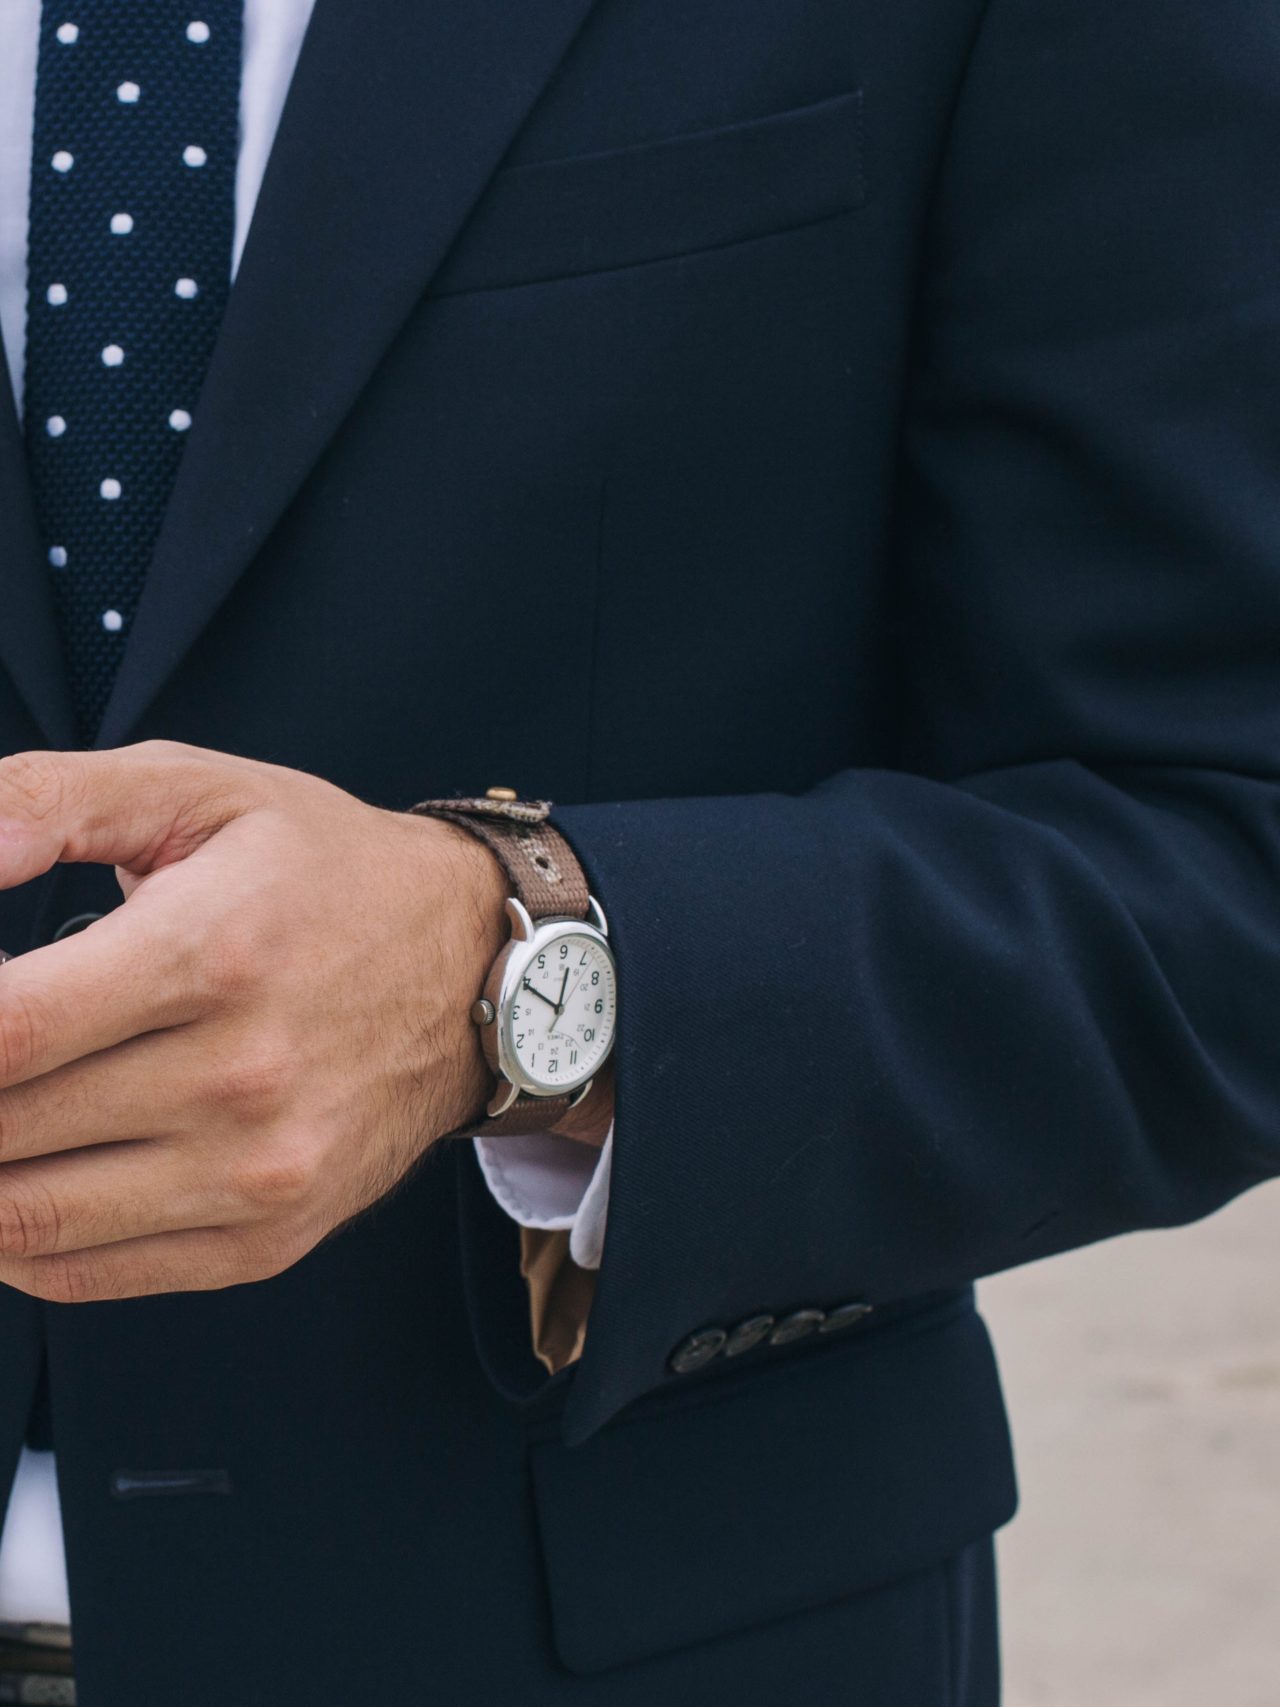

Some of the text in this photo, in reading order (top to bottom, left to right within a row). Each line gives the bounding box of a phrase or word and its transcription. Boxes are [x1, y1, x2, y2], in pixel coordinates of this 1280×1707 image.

[560, 945, 567, 959] 6
[580, 951, 586, 965] 7
[538, 954, 546, 969] 5
[592, 971, 599, 985] 8
[513, 1006, 520, 1019] 3
[594, 999, 602, 1013] 9
[516, 1034, 524, 1048] 2
[584, 1029, 595, 1042] 10
[570, 1050, 577, 1064] 11
[548, 1059, 558, 1073] 12
